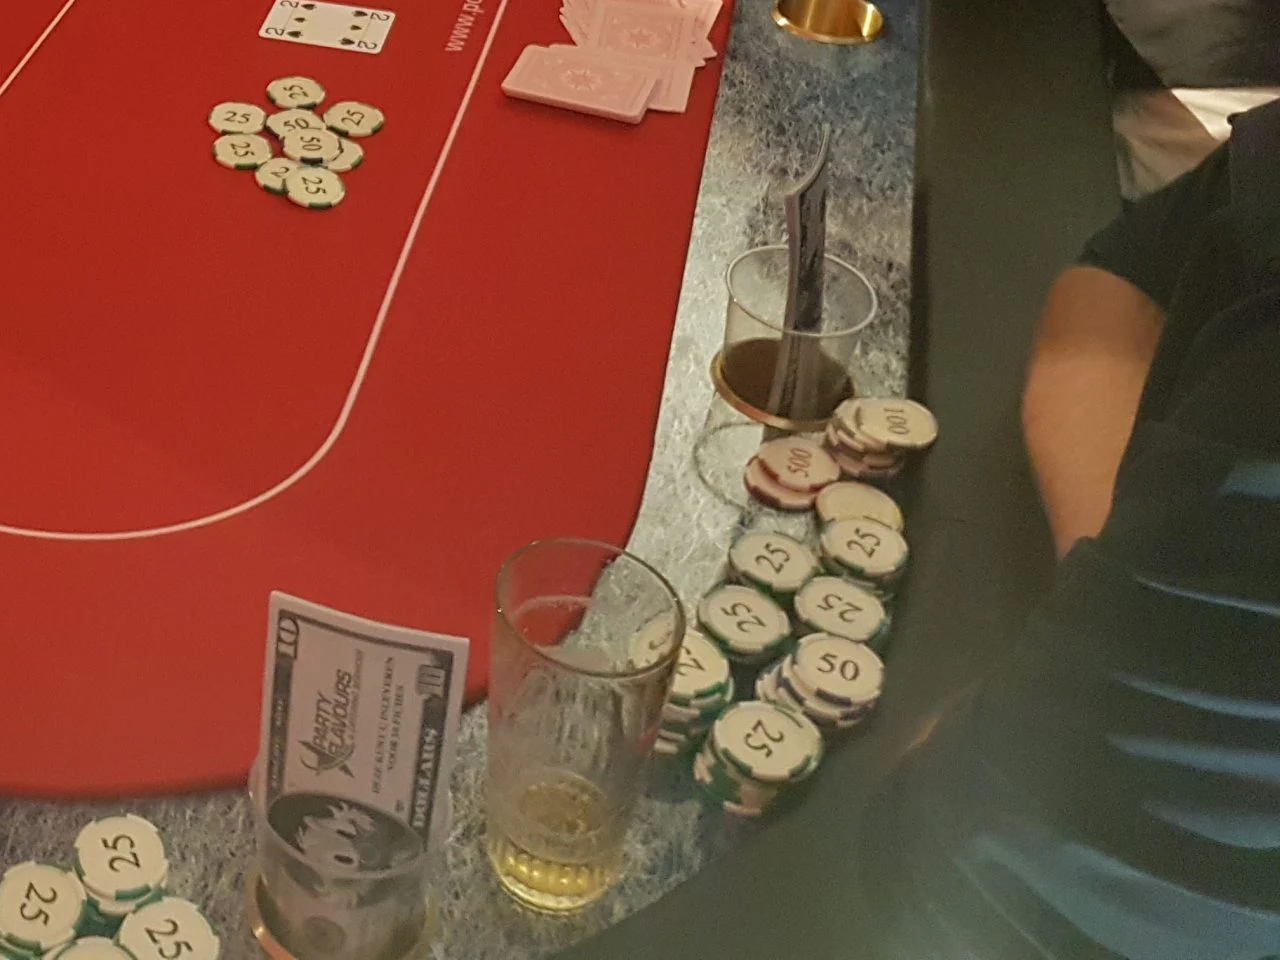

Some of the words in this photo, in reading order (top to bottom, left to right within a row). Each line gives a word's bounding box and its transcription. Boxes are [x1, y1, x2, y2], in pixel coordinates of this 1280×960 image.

[280, 0, 300, 8] 2
[370, 12, 390, 21] 2
[265, 27, 285, 36] 2
[357, 40, 377, 50] 2
[283, 84, 309, 99] 25
[223, 110, 251, 124] 25
[283, 117, 309, 132] 50
[341, 109, 365, 127] 25
[230, 142, 255, 158] 25
[300, 135, 322, 152] 50
[271, 166, 290, 178] 2
[301, 176, 327, 195] 25
[884, 407, 910, 435] 100
[786, 447, 812, 477] 500
[847, 528, 882, 559] 25
[755, 542, 790, 574] 25
[720, 601, 767, 633] 25
[817, 592, 864, 623] 25
[816, 652, 861, 682] 50
[312, 690, 334, 747] PARTY
[326, 668, 353, 754] FLAVOURS
[743, 719, 785, 758] 25
[101, 833, 141, 872] 25
[20, 881, 58, 927] 25
[144, 918, 193, 960] 25
